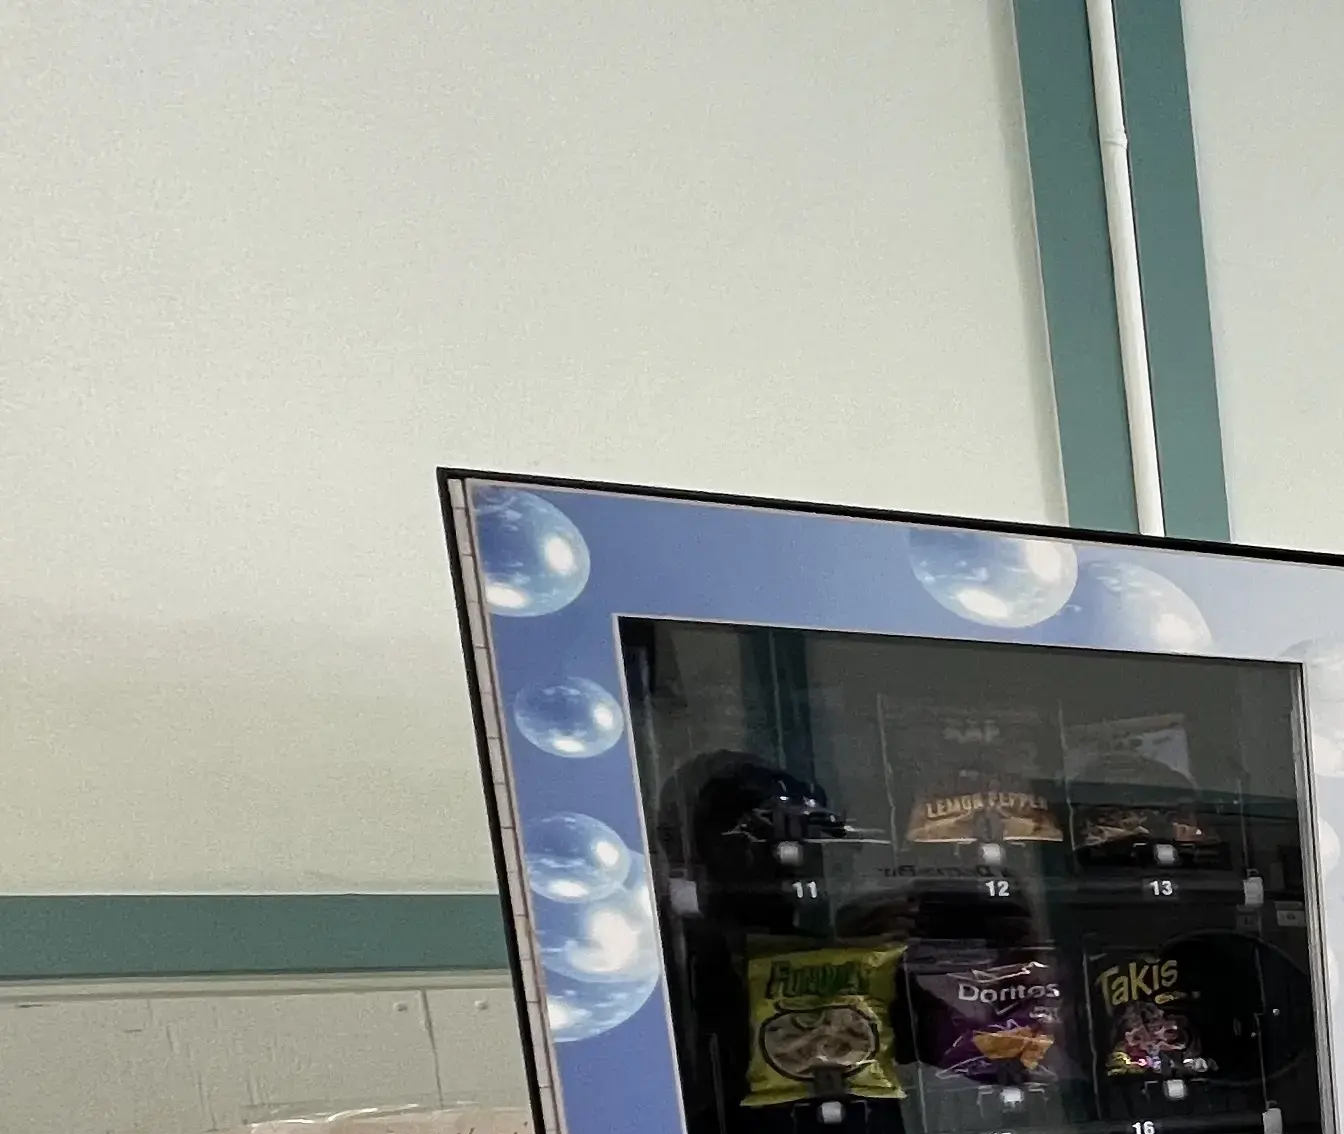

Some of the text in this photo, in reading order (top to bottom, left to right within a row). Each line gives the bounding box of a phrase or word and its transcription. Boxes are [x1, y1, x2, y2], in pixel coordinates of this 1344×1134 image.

[792, 880, 1174, 899] 11 12 13
[958, 983, 1060, 1004] Doritos
[1094, 959, 1179, 1017] Takis
